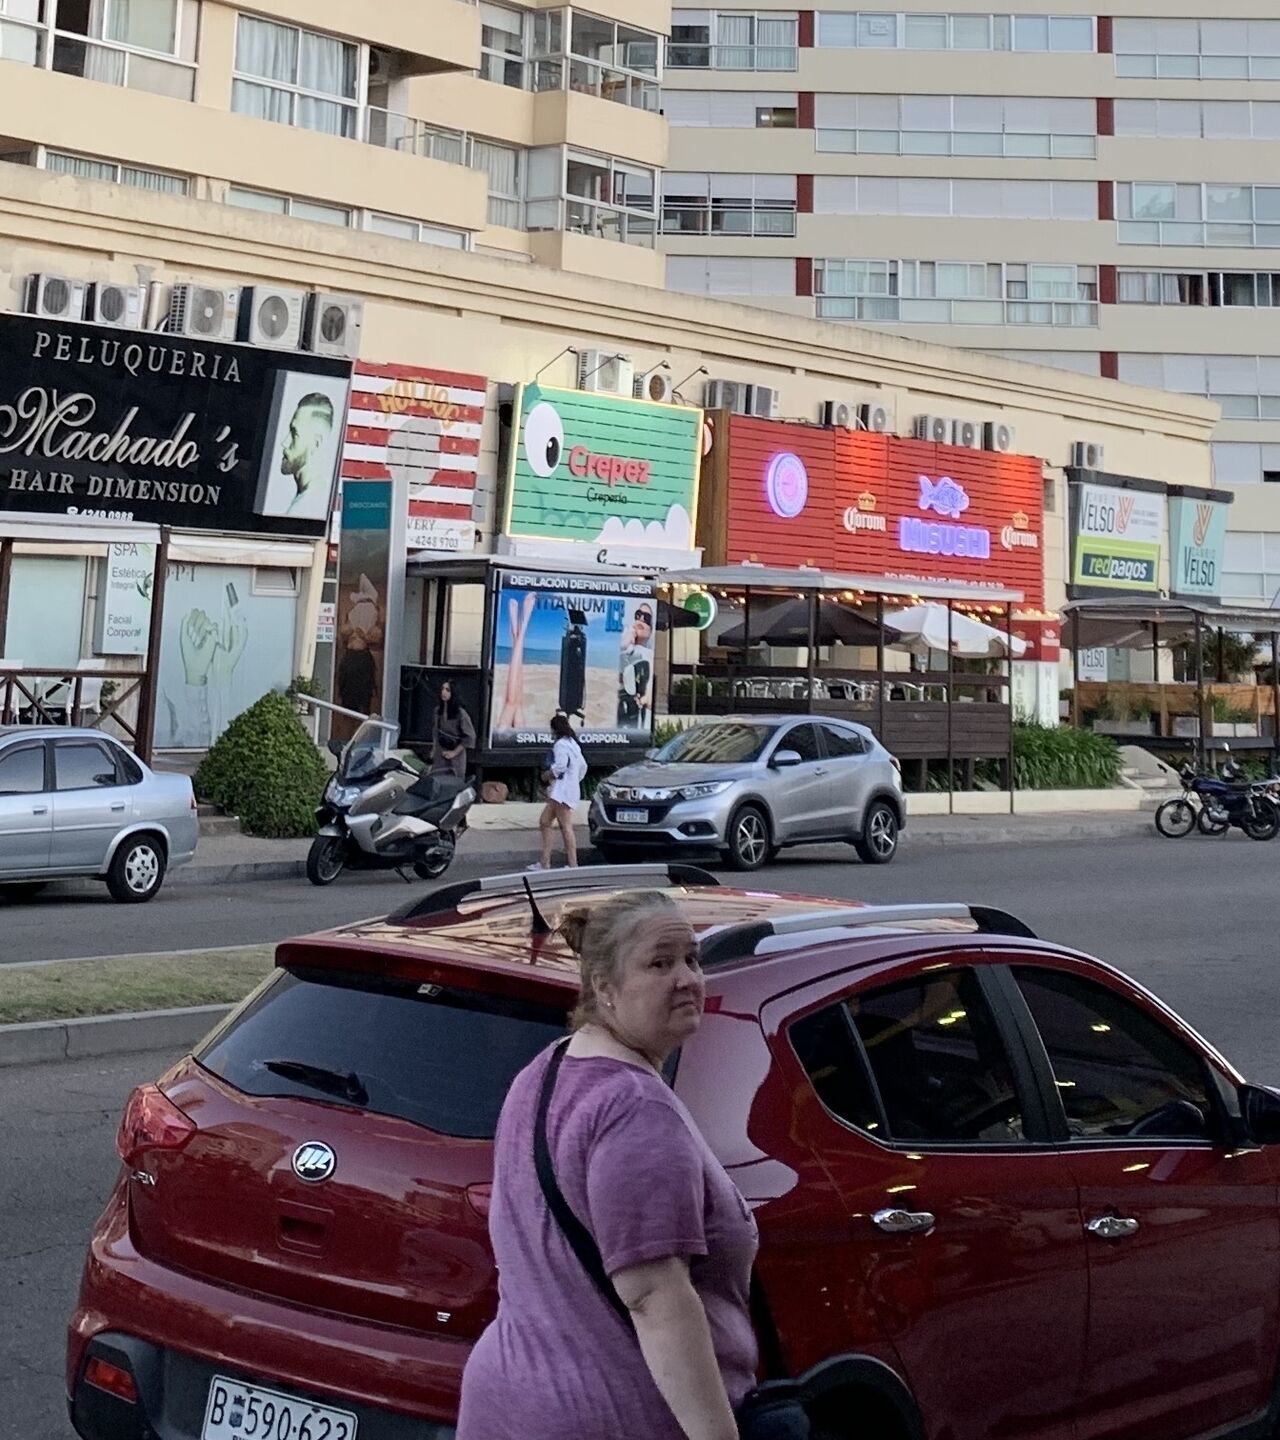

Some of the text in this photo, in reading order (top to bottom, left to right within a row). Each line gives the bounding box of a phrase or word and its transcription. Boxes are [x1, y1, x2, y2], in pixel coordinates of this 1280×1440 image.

[32, 331, 242, 383] PELUQUERIA
[569, 445, 651, 488] Crepez
[8, 468, 222, 506] HAIR DIMENSION
[843, 506, 887, 535] Corona
[1080, 491, 1115, 534] VELSO
[113, 543, 139, 557] SPA
[1001, 526, 1038, 551] Corona
[111, 566, 147, 579] Estética
[1088, 554, 1148, 582] redpagos
[1184, 545, 1216, 586] VELSO
[570, 579, 620, 593] DEFINITIVA
[534, 593, 606, 614] TITANIUM
[108, 614, 132, 625] Facial
[106, 628, 142, 638] Corporal
[579, 733, 630, 744] CORPORAL
